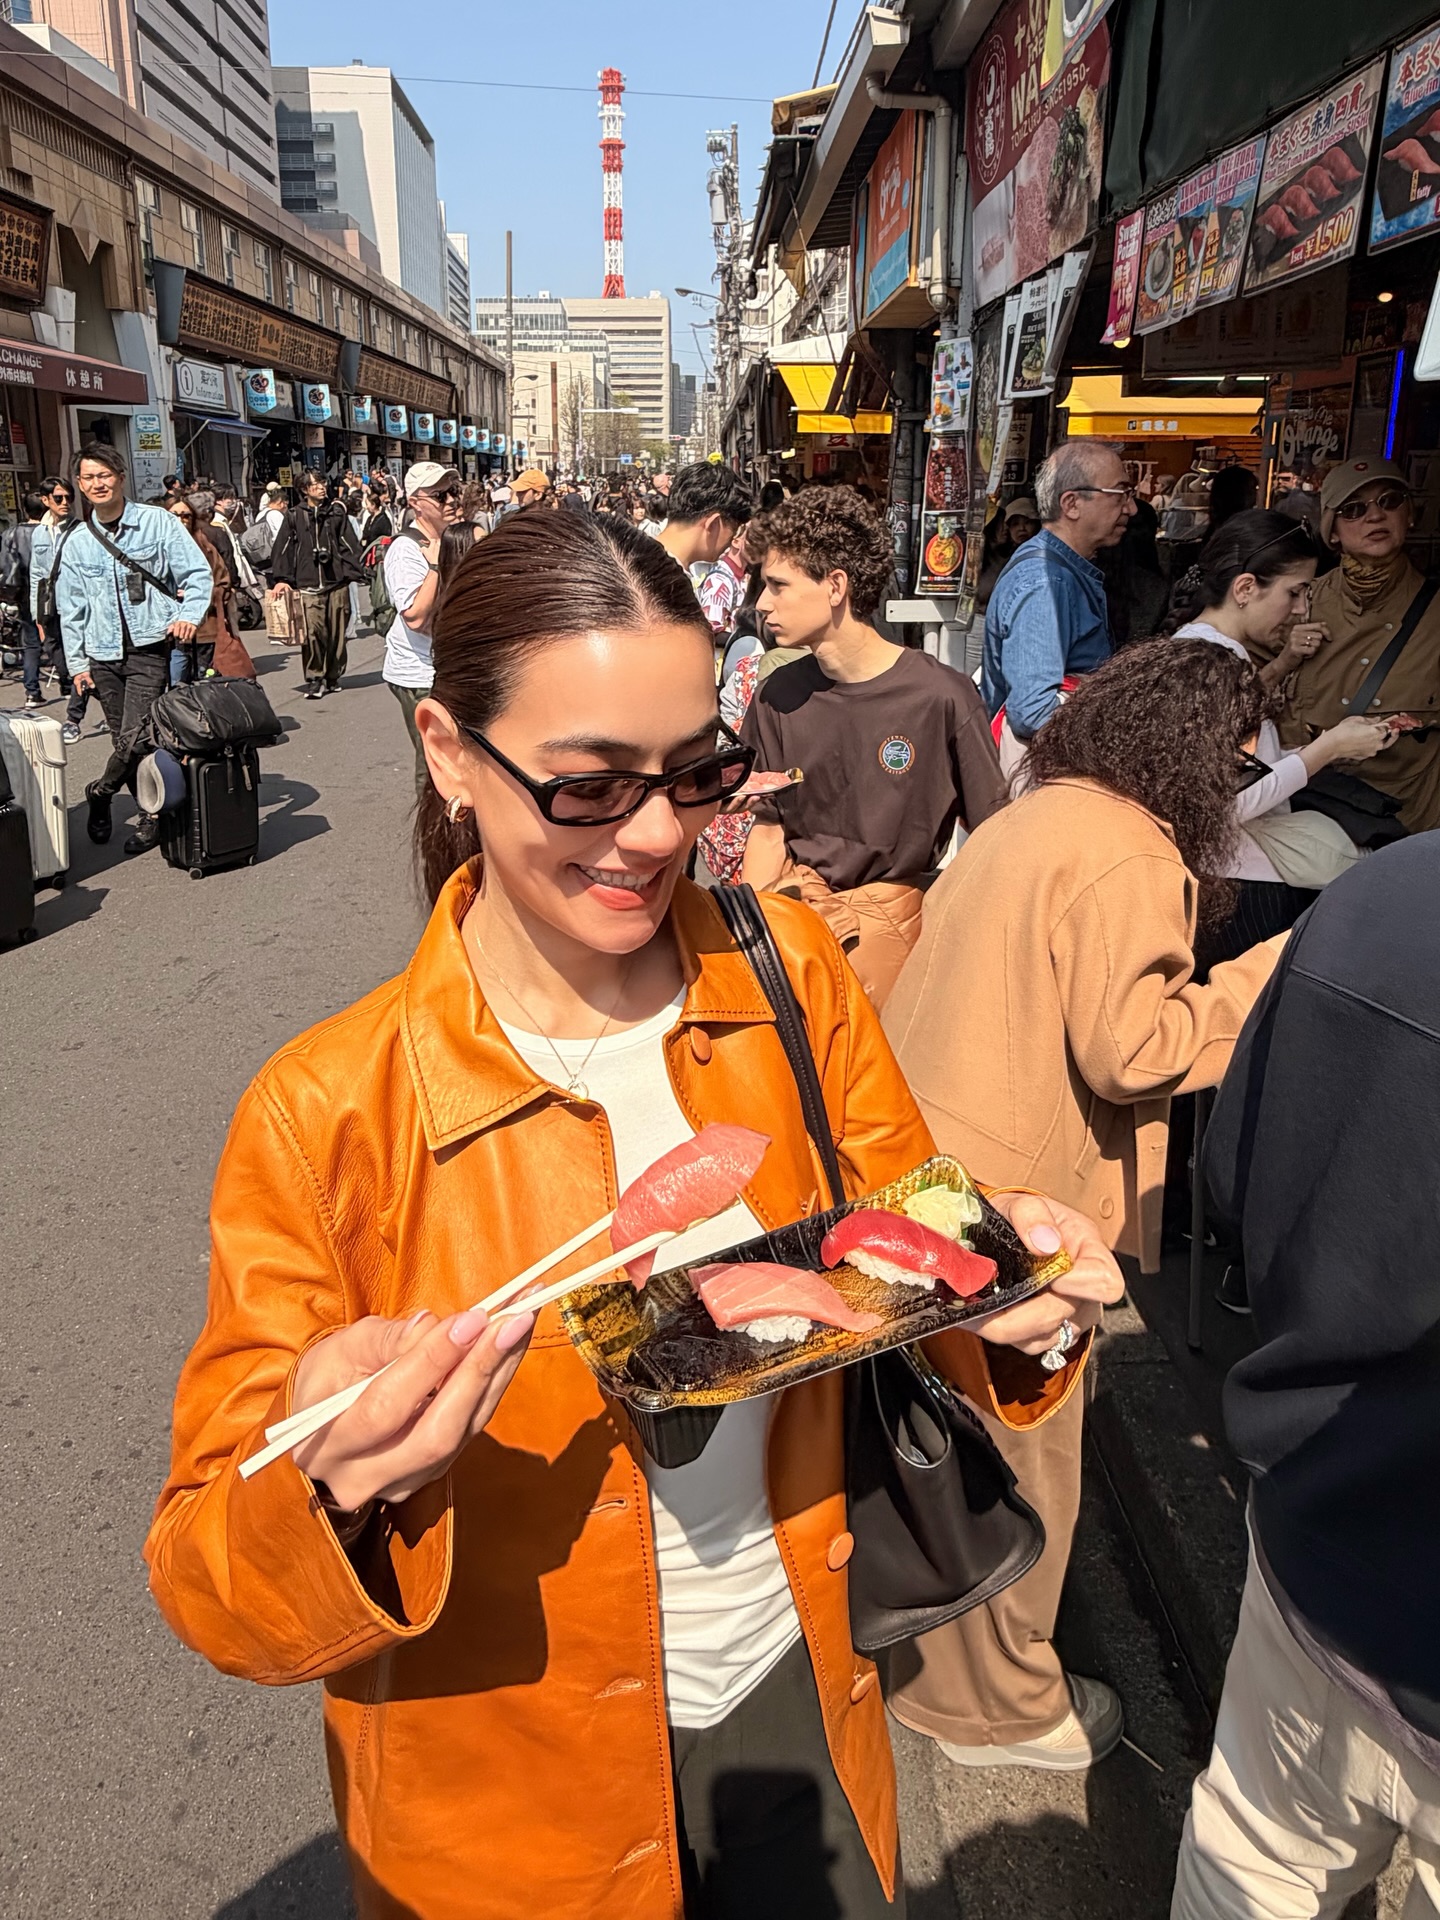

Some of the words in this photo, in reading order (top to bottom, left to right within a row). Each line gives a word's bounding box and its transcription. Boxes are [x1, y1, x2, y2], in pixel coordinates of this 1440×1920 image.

[1403, 83, 1424, 108] Blue
[1347, 111, 1370, 137] SUSHI
[1118, 217, 1141, 241] Sweet
[1117, 238, 1139, 262] Potato
[0, 348, 43, 369] CHANGE
[66, 367, 104, 391] 休憩所
[196, 386, 224, 401] Information
[1281, 424, 1339, 467] Orange
